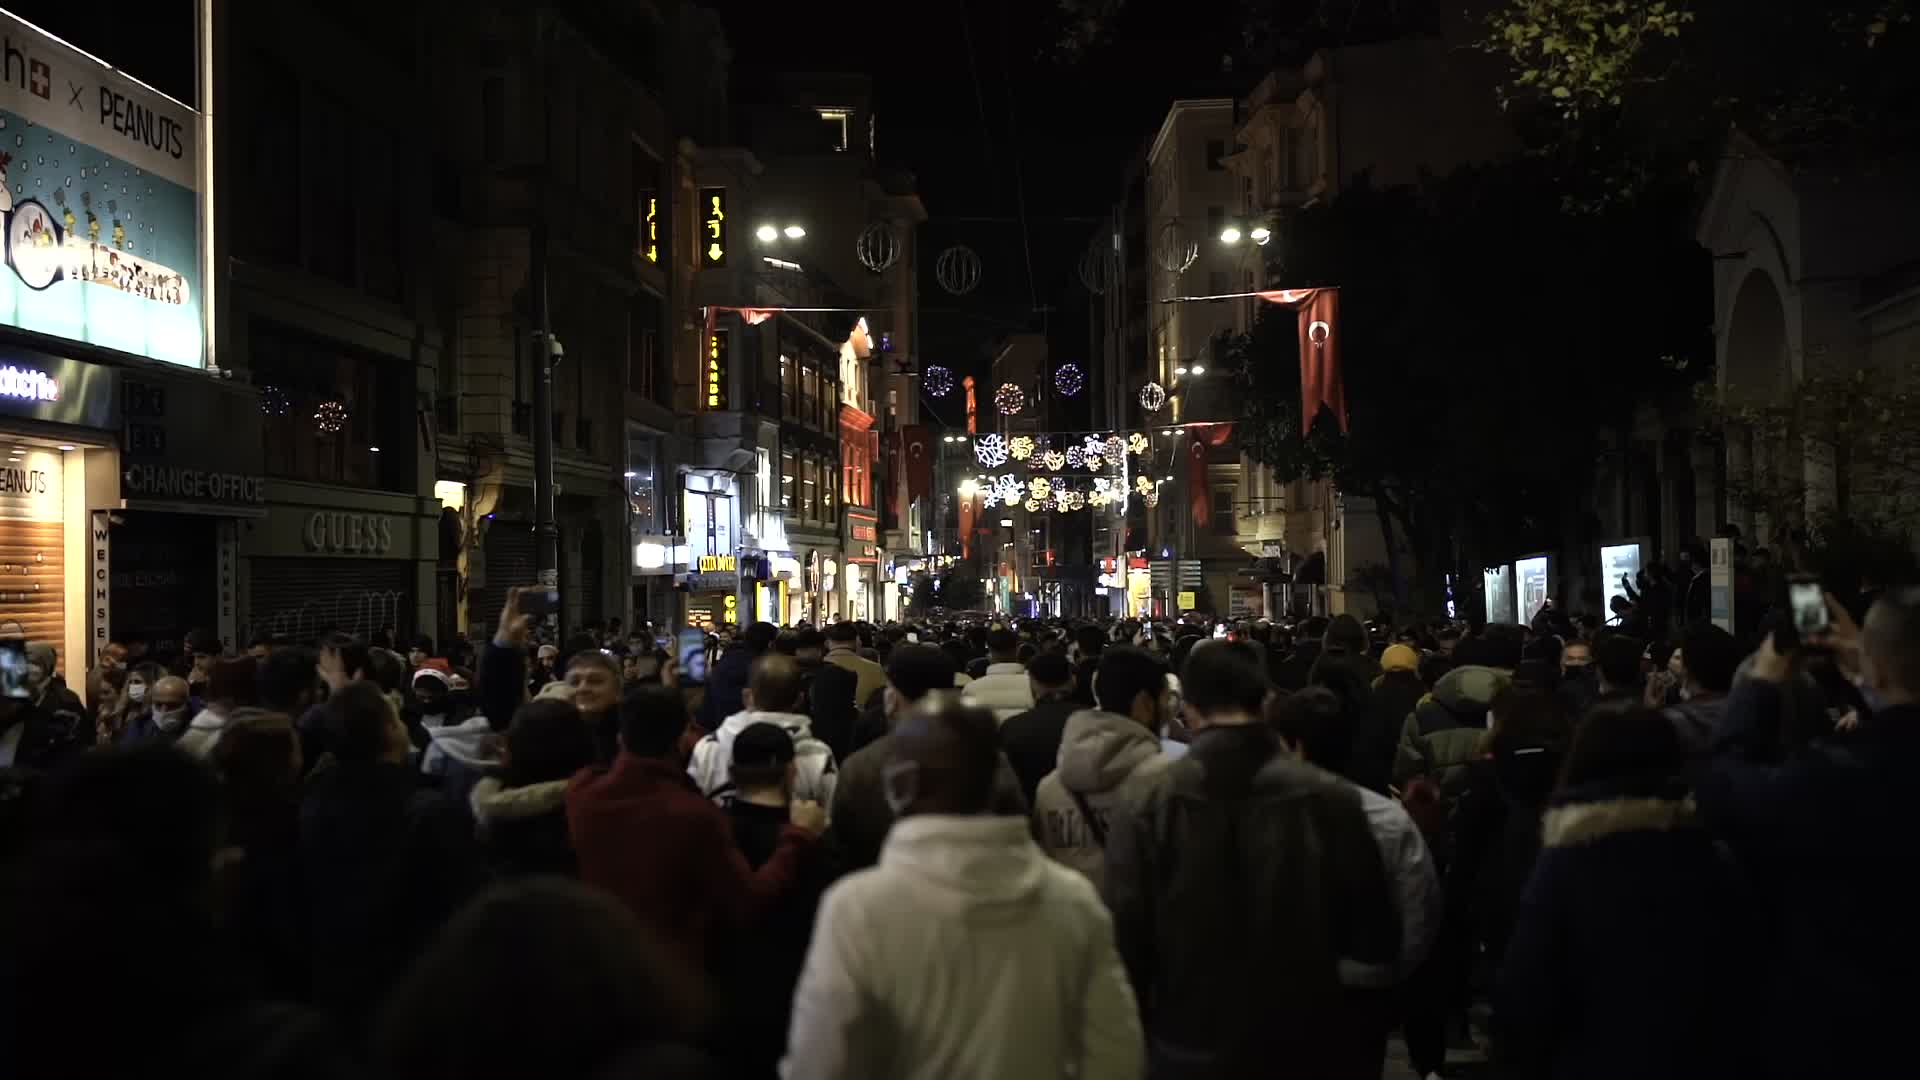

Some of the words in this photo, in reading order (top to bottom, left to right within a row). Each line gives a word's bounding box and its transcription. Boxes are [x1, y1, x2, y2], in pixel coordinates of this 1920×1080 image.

[100, 86, 183, 160] PEANUTS
[128, 464, 207, 497] CHANGE
[208, 473, 264, 504] OFFICE
[311, 511, 392, 552] GUESS
